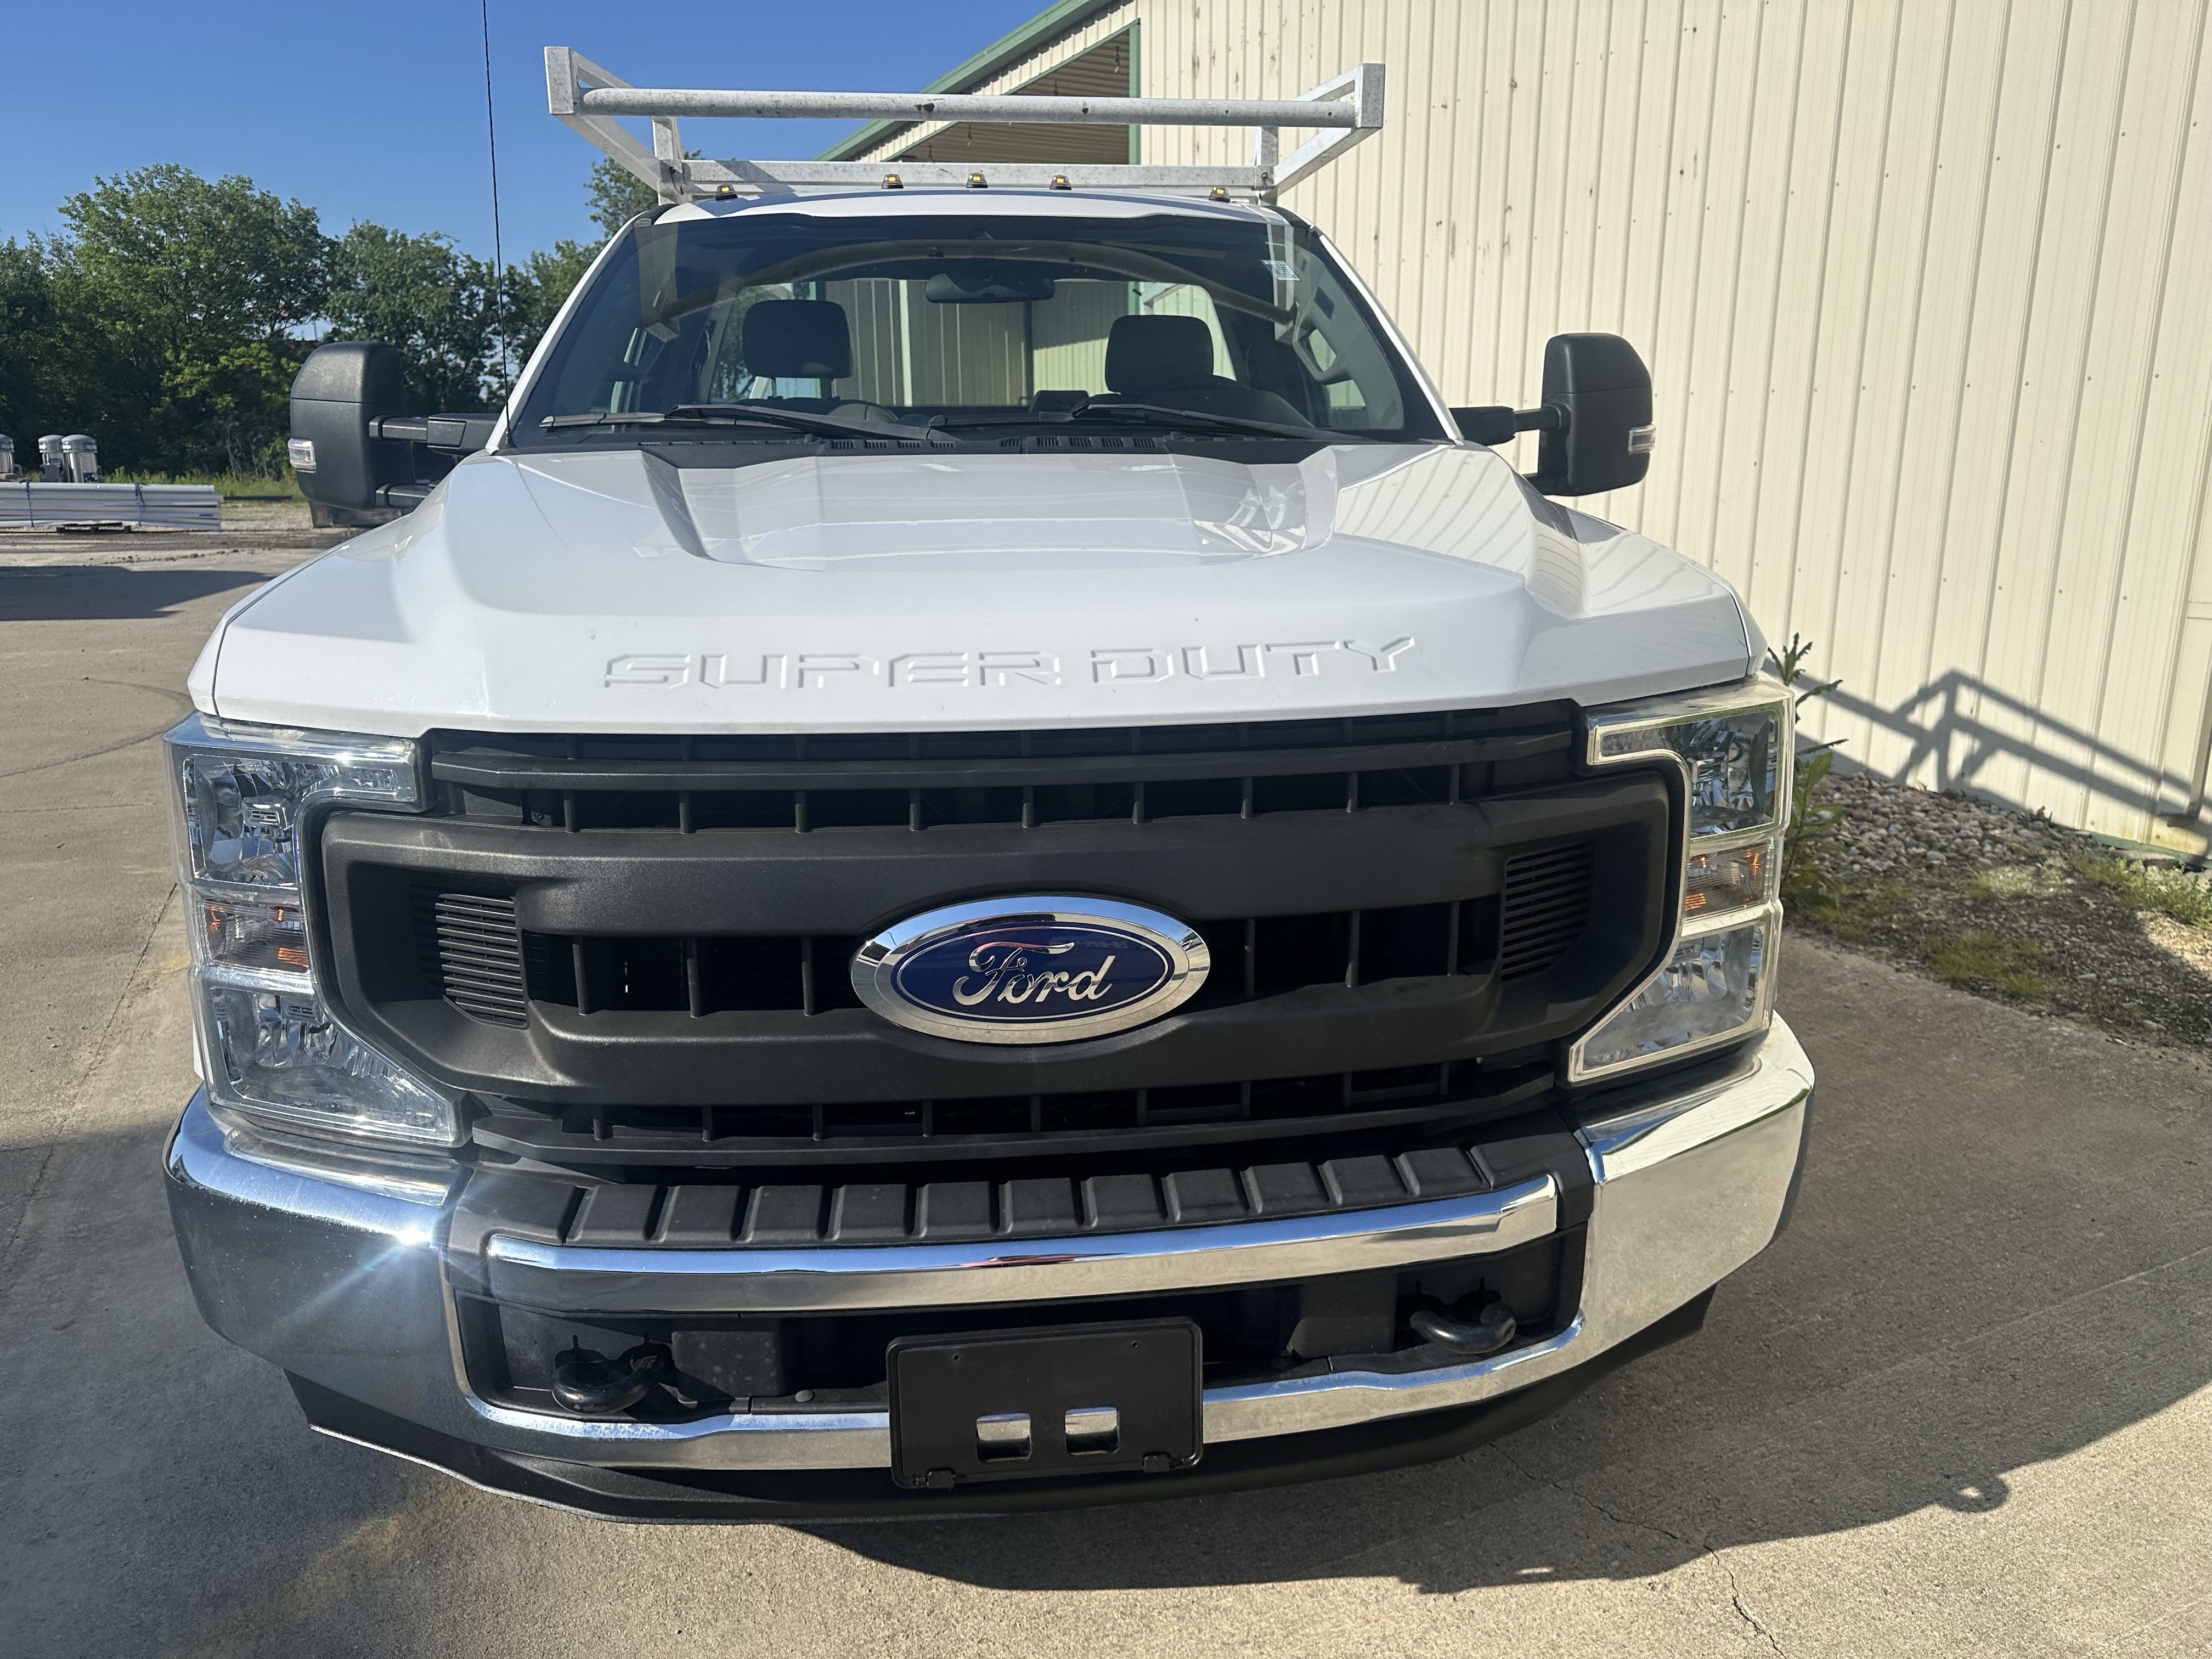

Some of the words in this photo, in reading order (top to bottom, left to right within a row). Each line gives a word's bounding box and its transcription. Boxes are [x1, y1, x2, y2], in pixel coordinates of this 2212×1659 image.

[604, 651, 1061, 689] SUPER
[1091, 637, 1415, 684] DUTY
[952, 941, 1116, 1006] Ford
